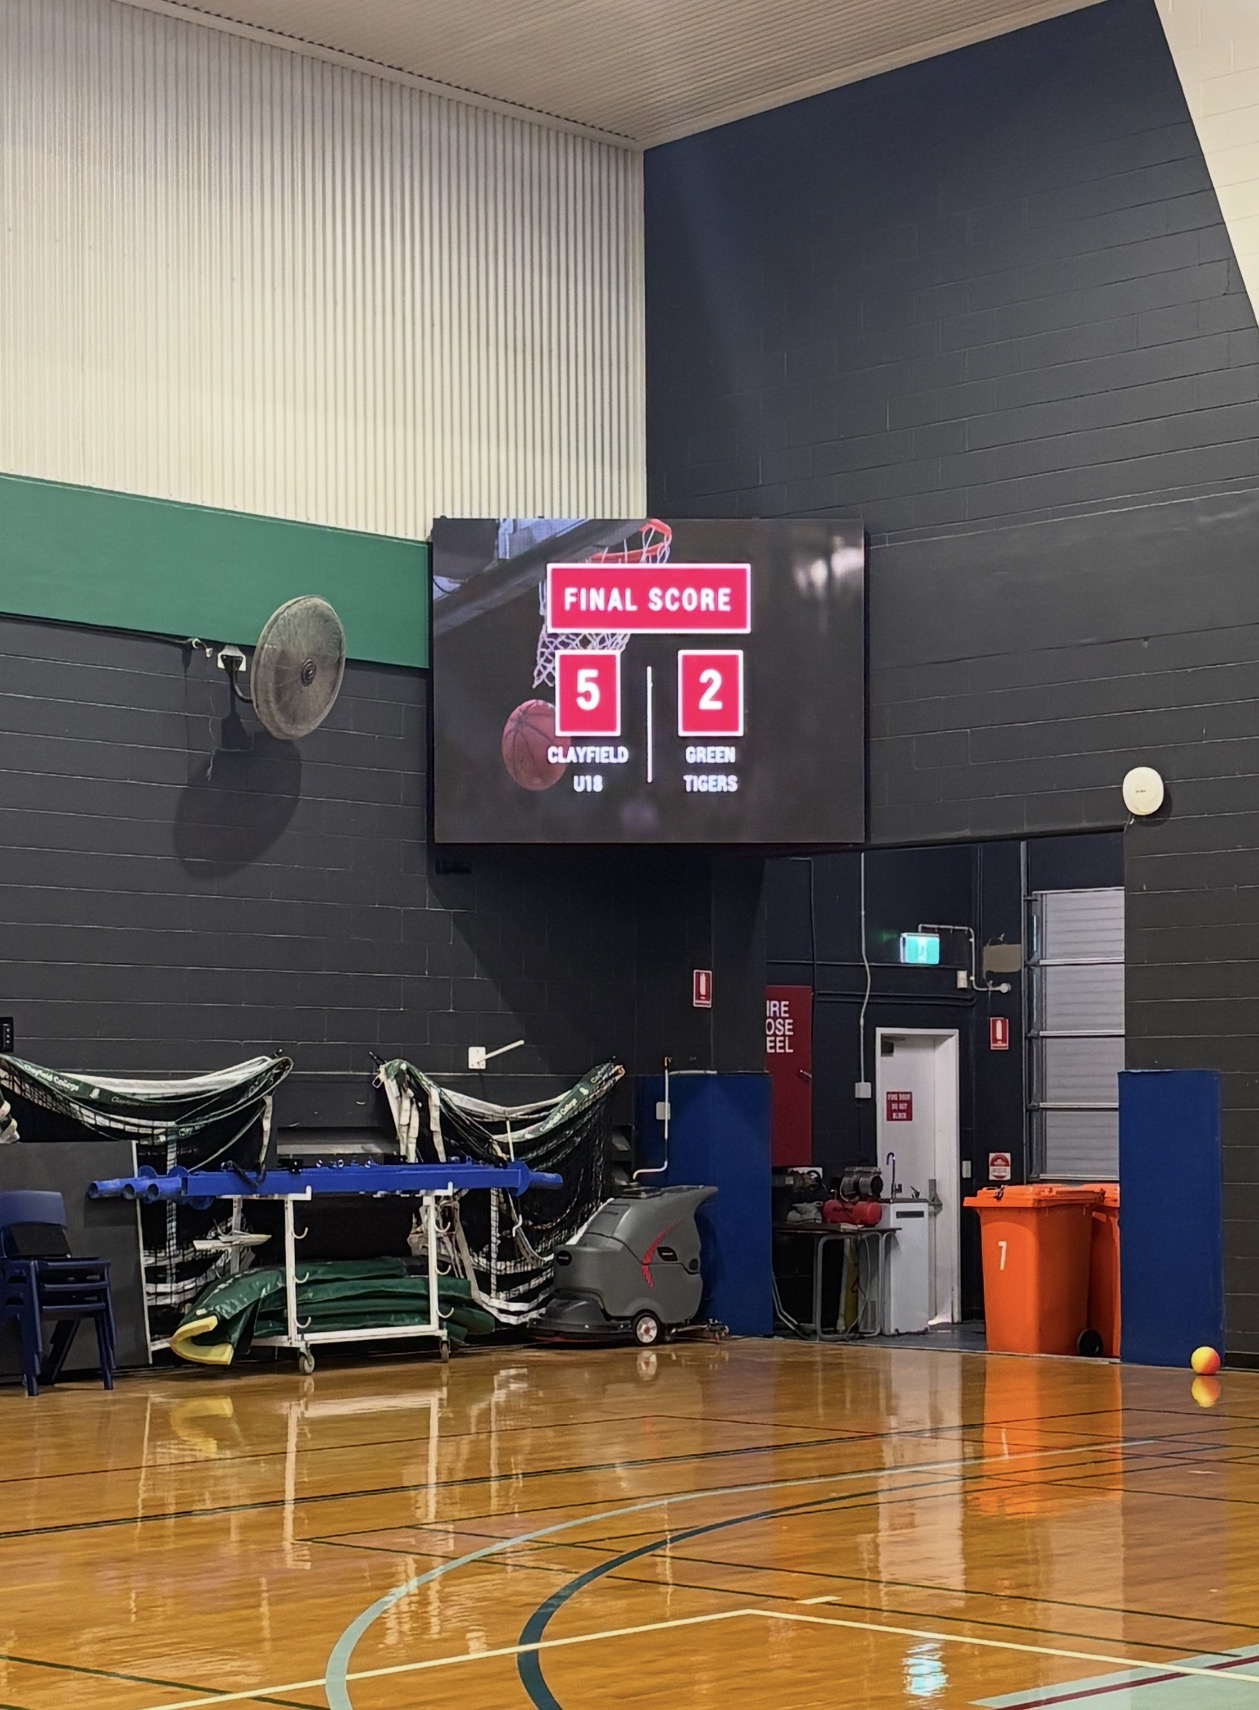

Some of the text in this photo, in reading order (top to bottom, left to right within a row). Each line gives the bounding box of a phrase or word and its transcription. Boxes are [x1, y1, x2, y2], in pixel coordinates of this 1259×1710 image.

[564, 587, 732, 612] FINAL SCORE
[576, 669, 601, 711] 5
[699, 668, 723, 710] 2
[547, 746, 629, 764] CLAYFIELD
[685, 746, 736, 764] GREEN
[573, 775, 603, 792] U18
[683, 774, 738, 792] TIGERS
[766, 1000, 790, 1017] IRE
[765, 1018, 794, 1036] OSE
[766, 1036, 794, 1053] EEL
